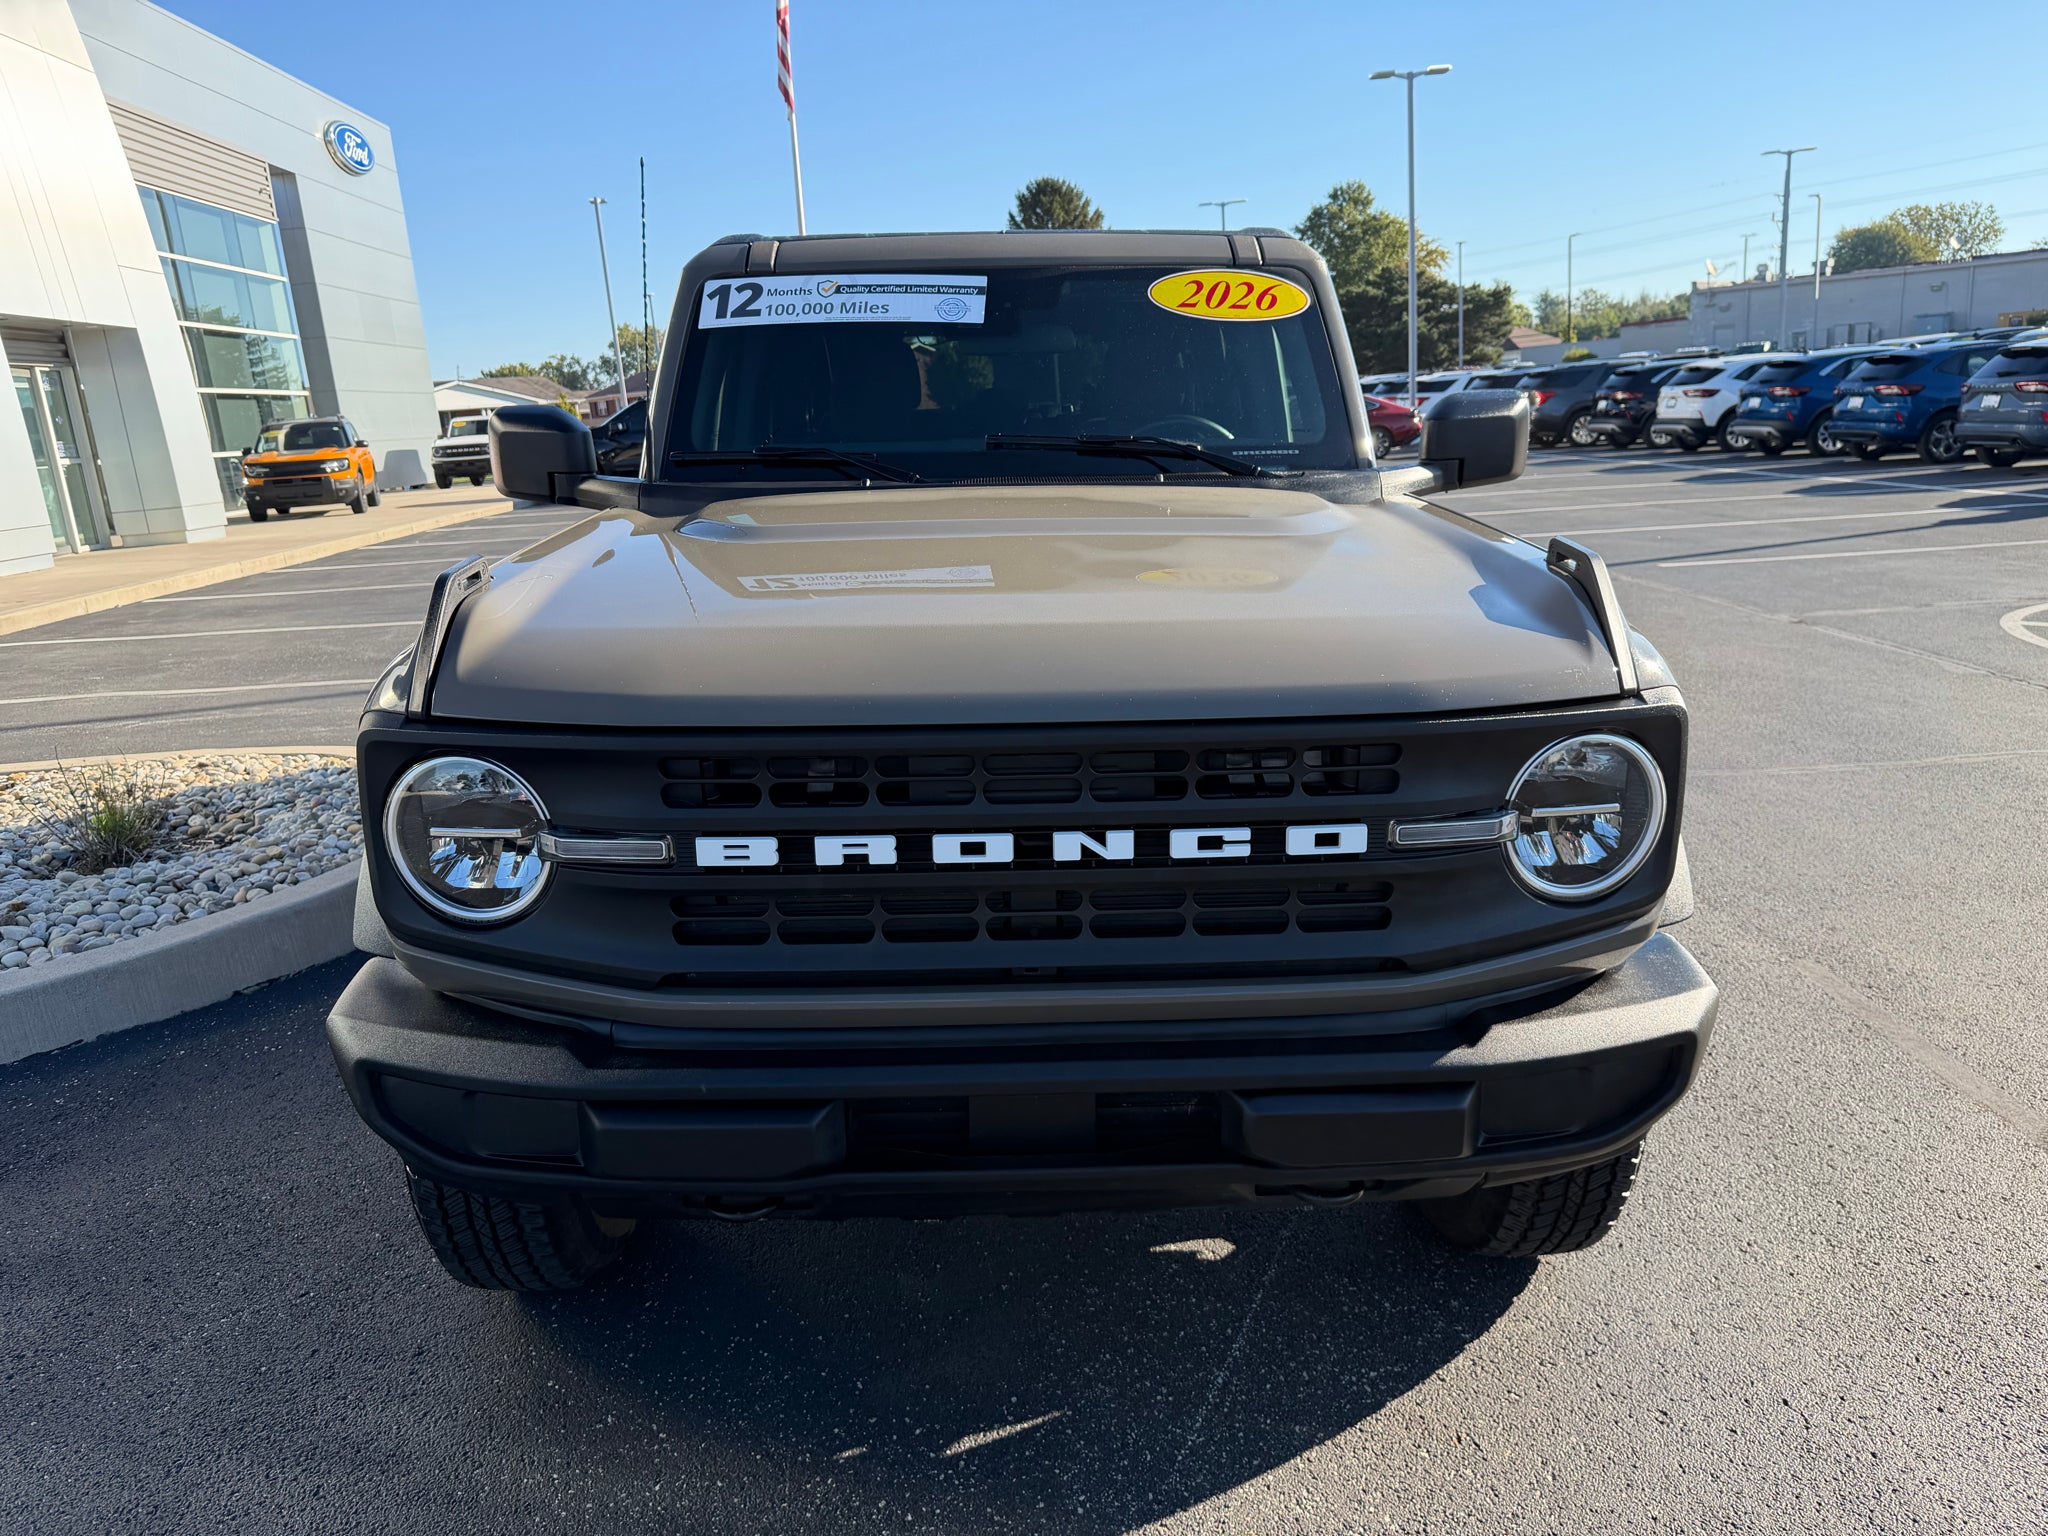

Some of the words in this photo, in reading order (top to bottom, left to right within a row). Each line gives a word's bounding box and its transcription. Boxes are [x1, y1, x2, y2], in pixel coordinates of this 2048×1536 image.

[344, 131, 369, 165] Ford
[706, 282, 764, 320] 12
[766, 287, 813, 297] Months
[840, 285, 870, 294] Quality
[870, 285, 906, 293] Certified
[907, 285, 938, 293] Limited
[939, 286, 979, 295] Warranty
[1176, 279, 1283, 311] 2026
[765, 302, 834, 318] 100,000
[840, 301, 890, 315] Miles
[695, 823, 1368, 867] BRONCO
